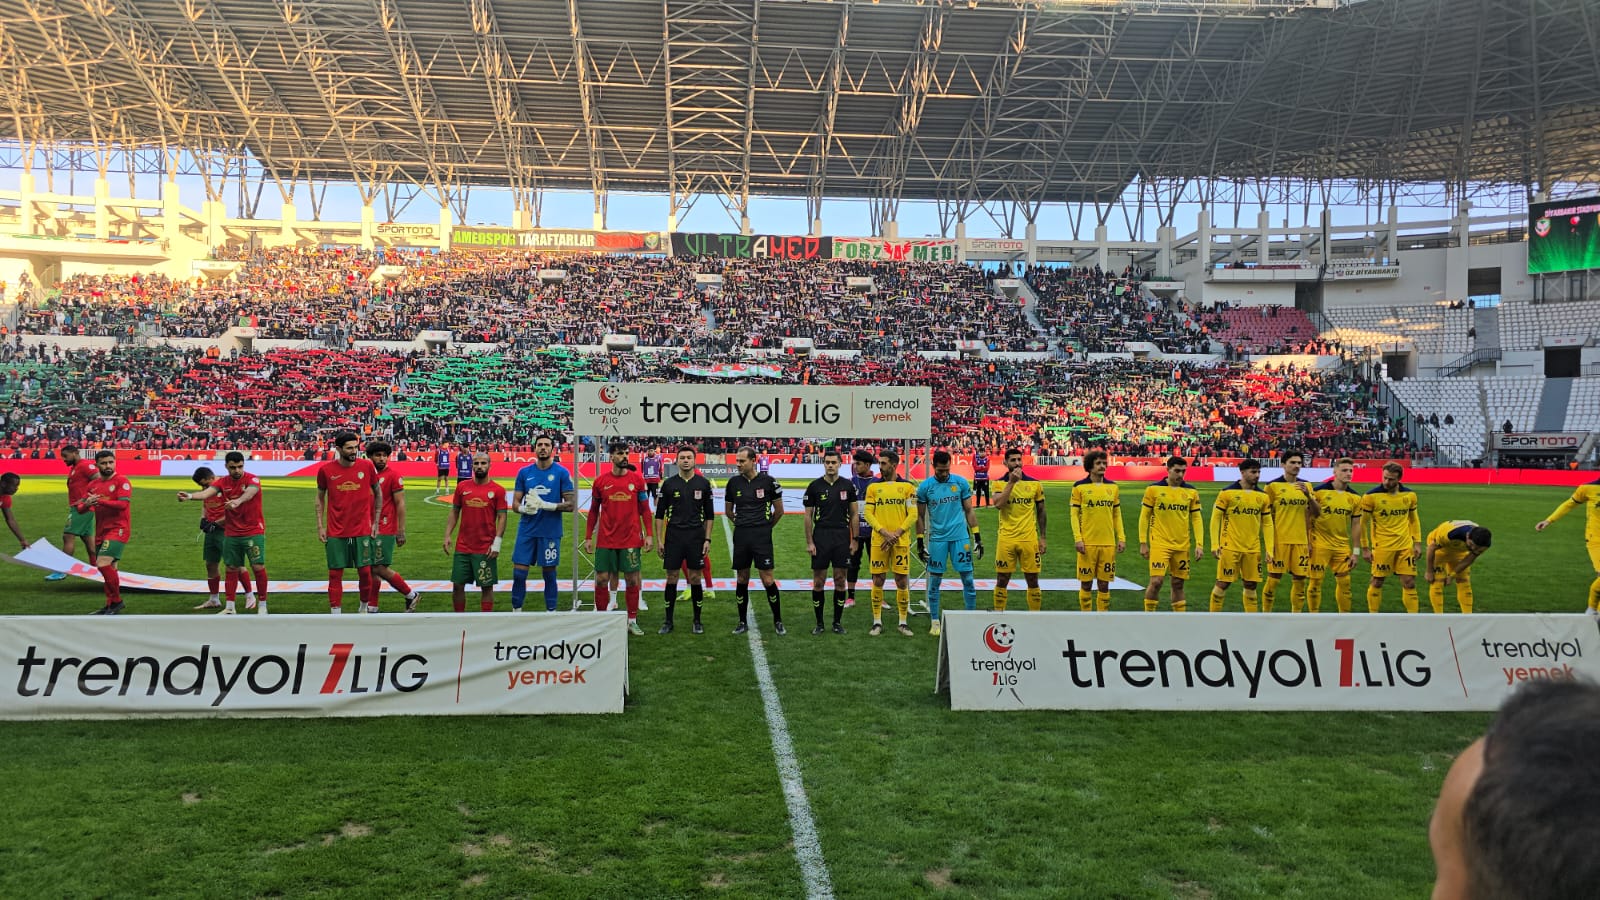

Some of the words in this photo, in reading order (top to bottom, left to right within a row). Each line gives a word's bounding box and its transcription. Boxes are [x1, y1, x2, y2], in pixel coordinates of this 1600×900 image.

[589, 406, 632, 416] trendyol
[640, 396, 779, 429] trendyol
[864, 397, 919, 411] trendyol
[872, 411, 912, 424] yemek
[544, 548, 557, 560] 96
[958, 552, 972, 563] 25
[1223, 568, 1234, 576] MI
[493, 638, 602, 665] trendyol
[1481, 637, 1583, 661] trendyol
[16, 643, 308, 707] trendyol
[970, 657, 1037, 674] trendyol
[1062, 638, 1323, 699] trendyol
[1502, 663, 1576, 686] yemek
[507, 665, 587, 690] yemek
